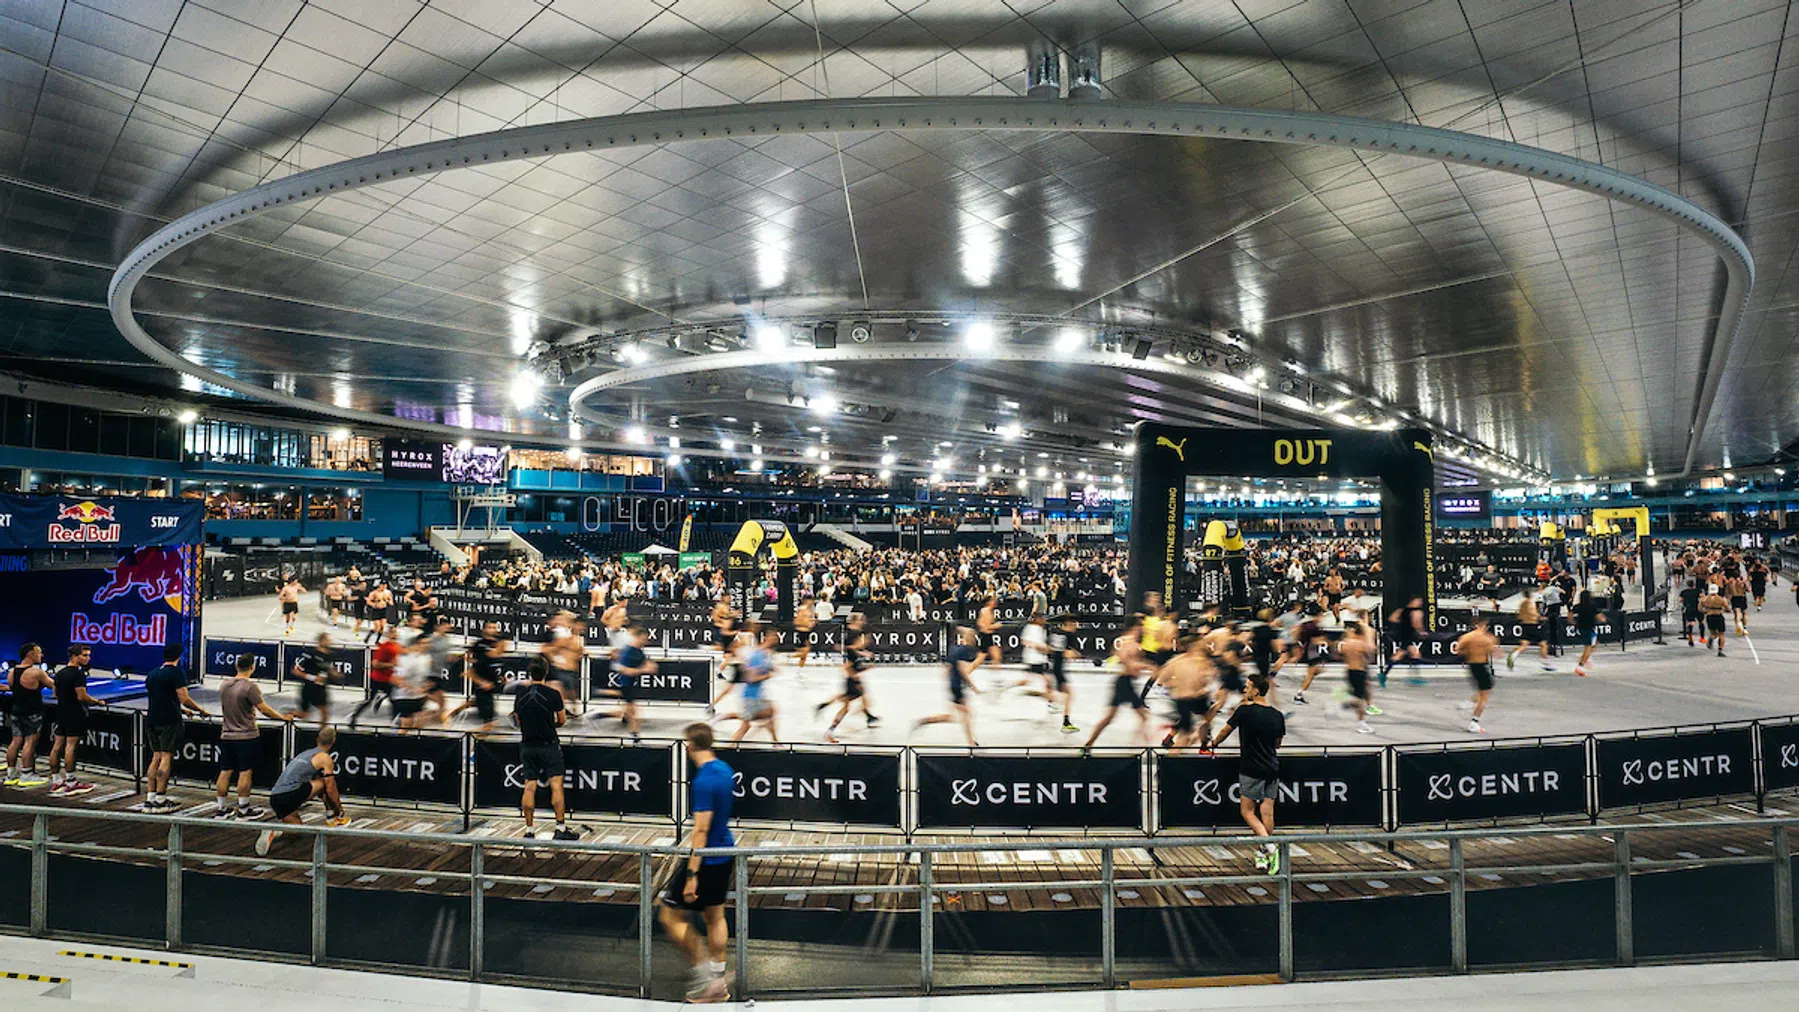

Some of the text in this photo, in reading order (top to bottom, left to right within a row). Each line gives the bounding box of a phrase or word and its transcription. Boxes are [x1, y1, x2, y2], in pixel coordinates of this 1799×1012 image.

[391, 450, 432, 461] HYROX
[1273, 439, 1332, 465] OUT
[1168, 487, 1178, 522] RACING
[1422, 488, 1432, 521] RACING
[48, 523, 121, 543] Red Bull
[150, 516, 180, 528] START
[1166, 524, 1177, 562] FITNESS
[1424, 522, 1434, 558] FITNESS
[1165, 563, 1175, 577] OF
[1425, 560, 1435, 572] OF
[967, 608, 1022, 620] HROX
[70, 611, 168, 647] Red Bull
[472, 618, 510, 634] HYOX
[860, 631, 934, 646] YROX
[955, 633, 1021, 648] HYRO
[1076, 636, 1122, 651] YRO
[1391, 641, 1460, 656] HYRO
[226, 653, 267, 668] CETR
[633, 674, 693, 689] ENTR
[79, 729, 120, 751] NTR
[183, 742, 222, 764] CEN
[343, 755, 436, 781] CENTR
[1647, 754, 1731, 781] CENTR
[750, 776, 868, 801] CENTR
[986, 782, 1108, 804] CENTR
[1228, 781, 1348, 803] CNTR
[1457, 771, 1560, 797] CENTR
